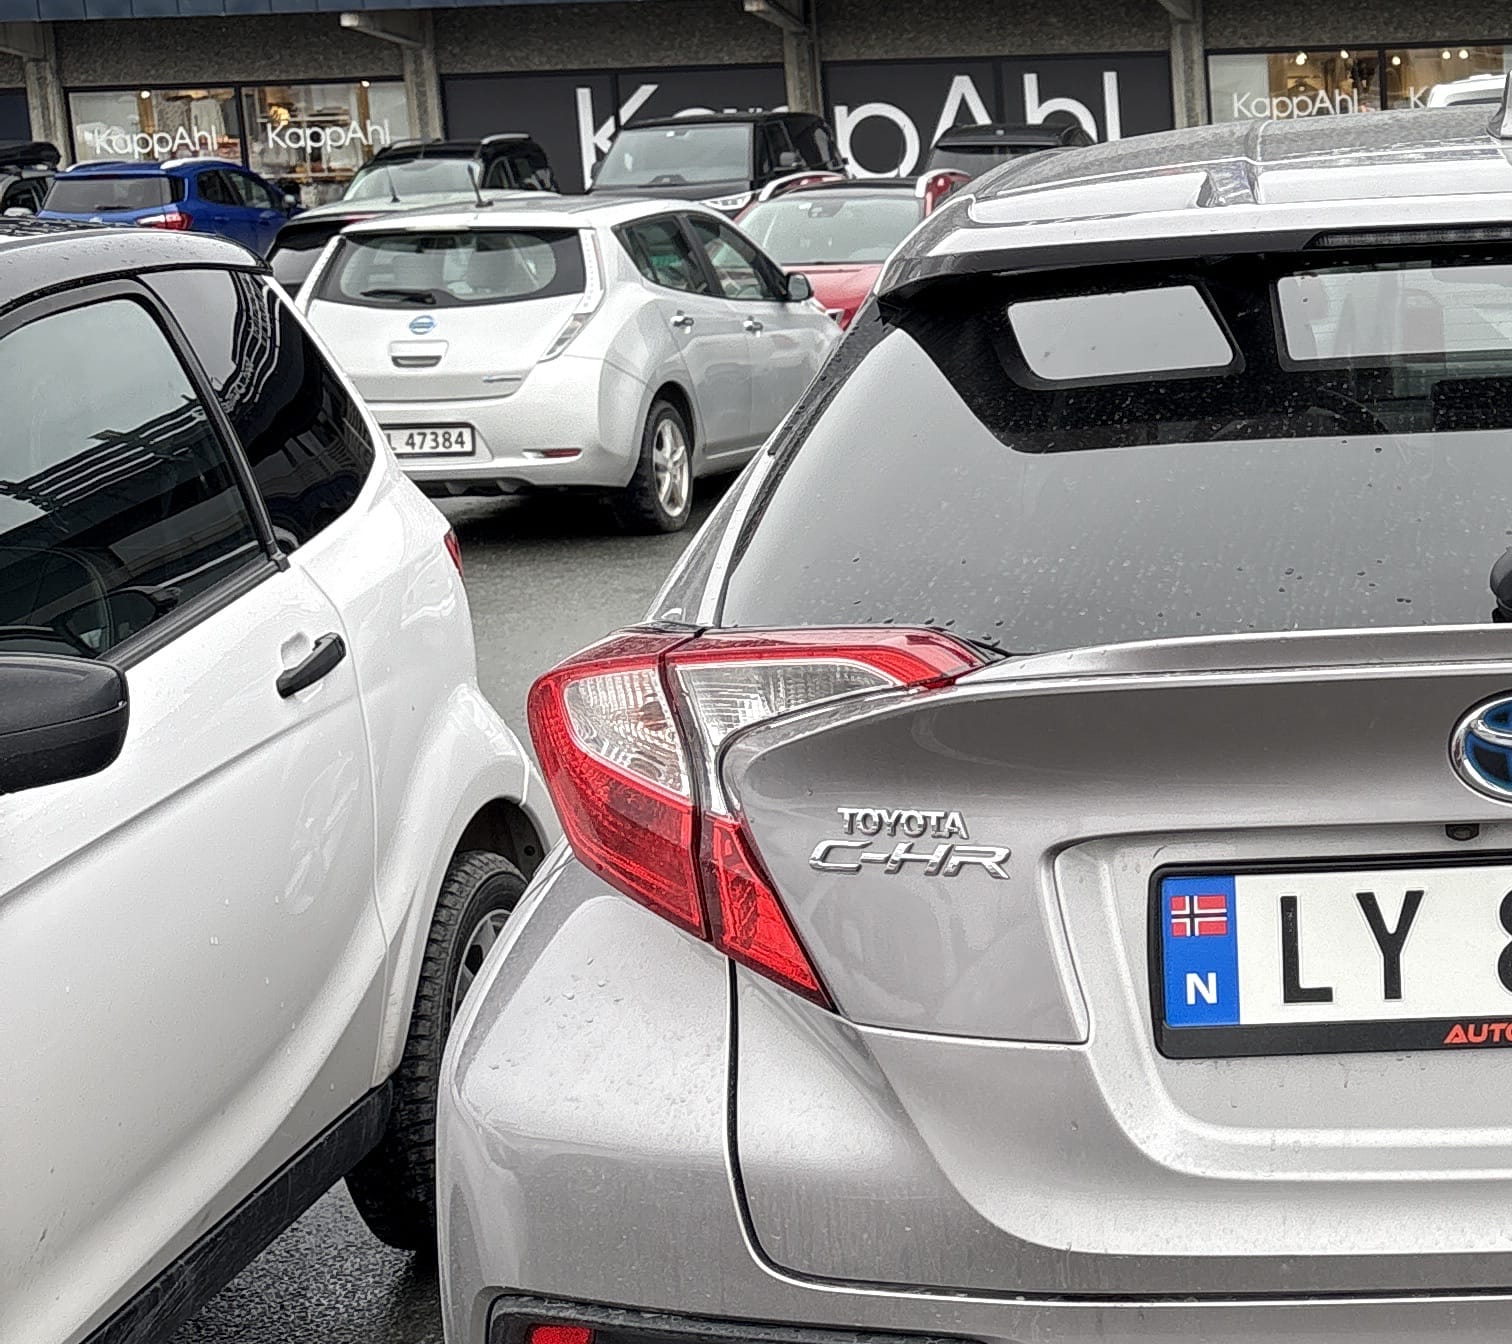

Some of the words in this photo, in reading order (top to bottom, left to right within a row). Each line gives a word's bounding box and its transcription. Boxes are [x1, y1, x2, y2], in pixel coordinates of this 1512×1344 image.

[1232, 88, 1359, 120] KappAhl
[94, 125, 218, 159] KappAhl
[267, 119, 390, 154] KappAhl
[576, 71, 1121, 192] KpAhl
[405, 431, 466, 450] 47384
[836, 807, 970, 840] TOYOTA
[808, 839, 1012, 880] C-HR
[1279, 889, 1426, 1006] LY
[1185, 971, 1218, 1005] N
